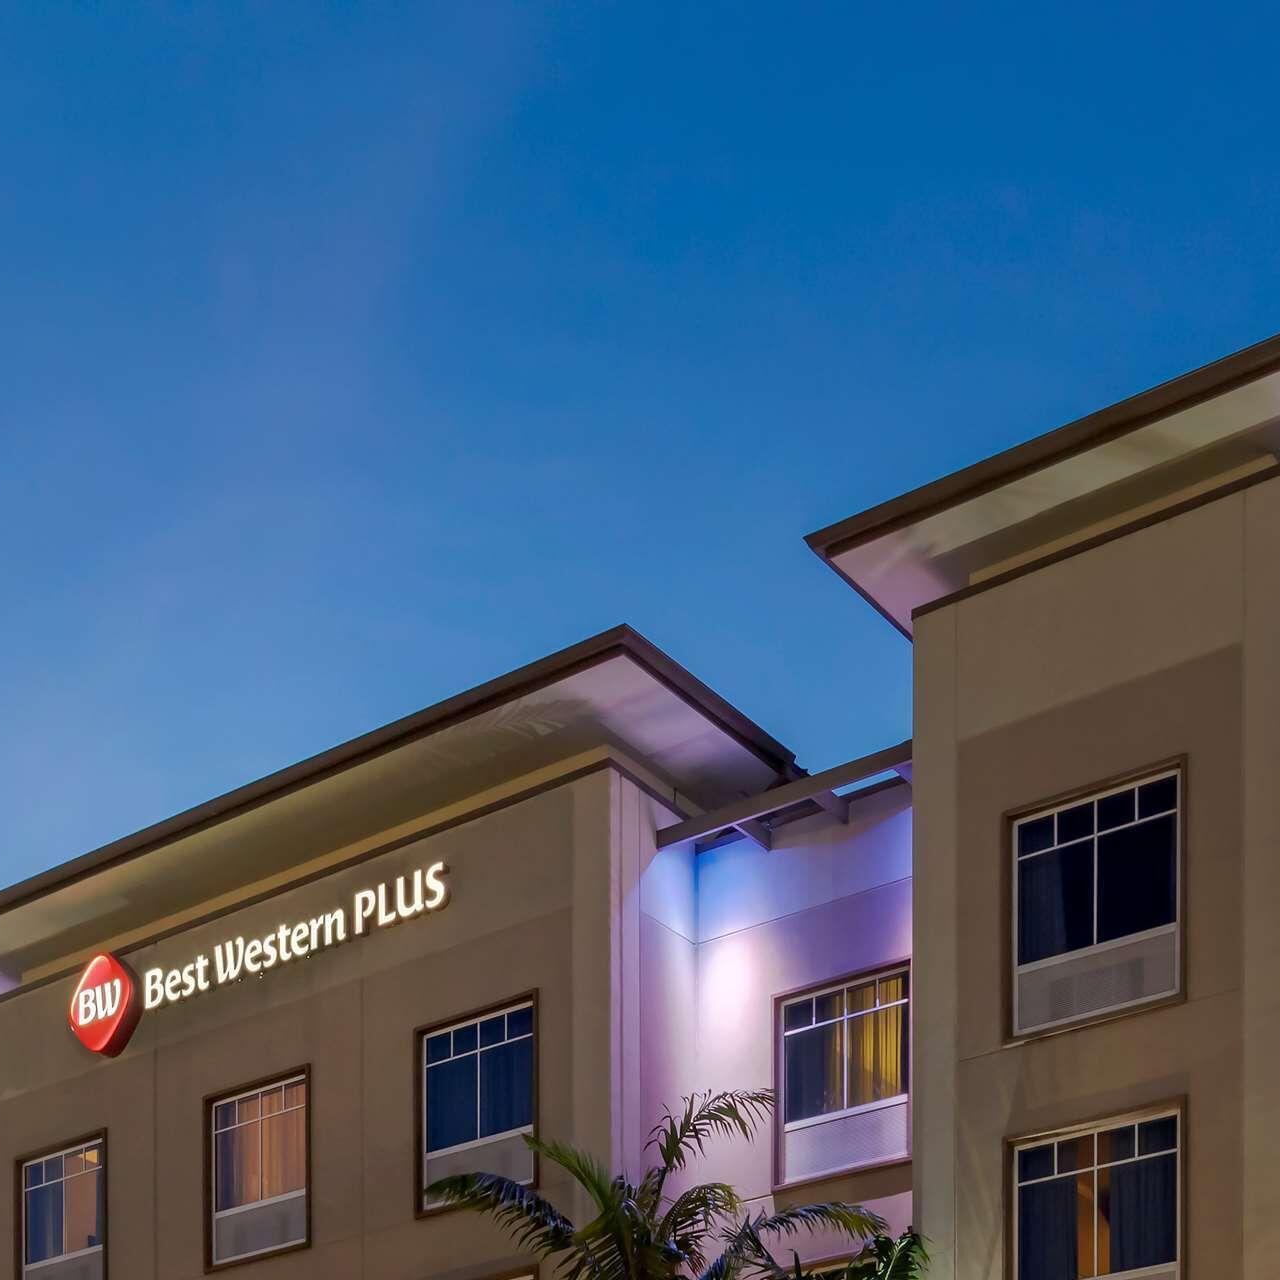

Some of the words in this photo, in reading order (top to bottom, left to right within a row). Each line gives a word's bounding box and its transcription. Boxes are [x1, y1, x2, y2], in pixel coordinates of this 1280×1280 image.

[143, 954, 210, 1010] Best
[214, 907, 347, 984] Western
[354, 861, 446, 934] PLUS
[78, 979, 121, 1025] BW
